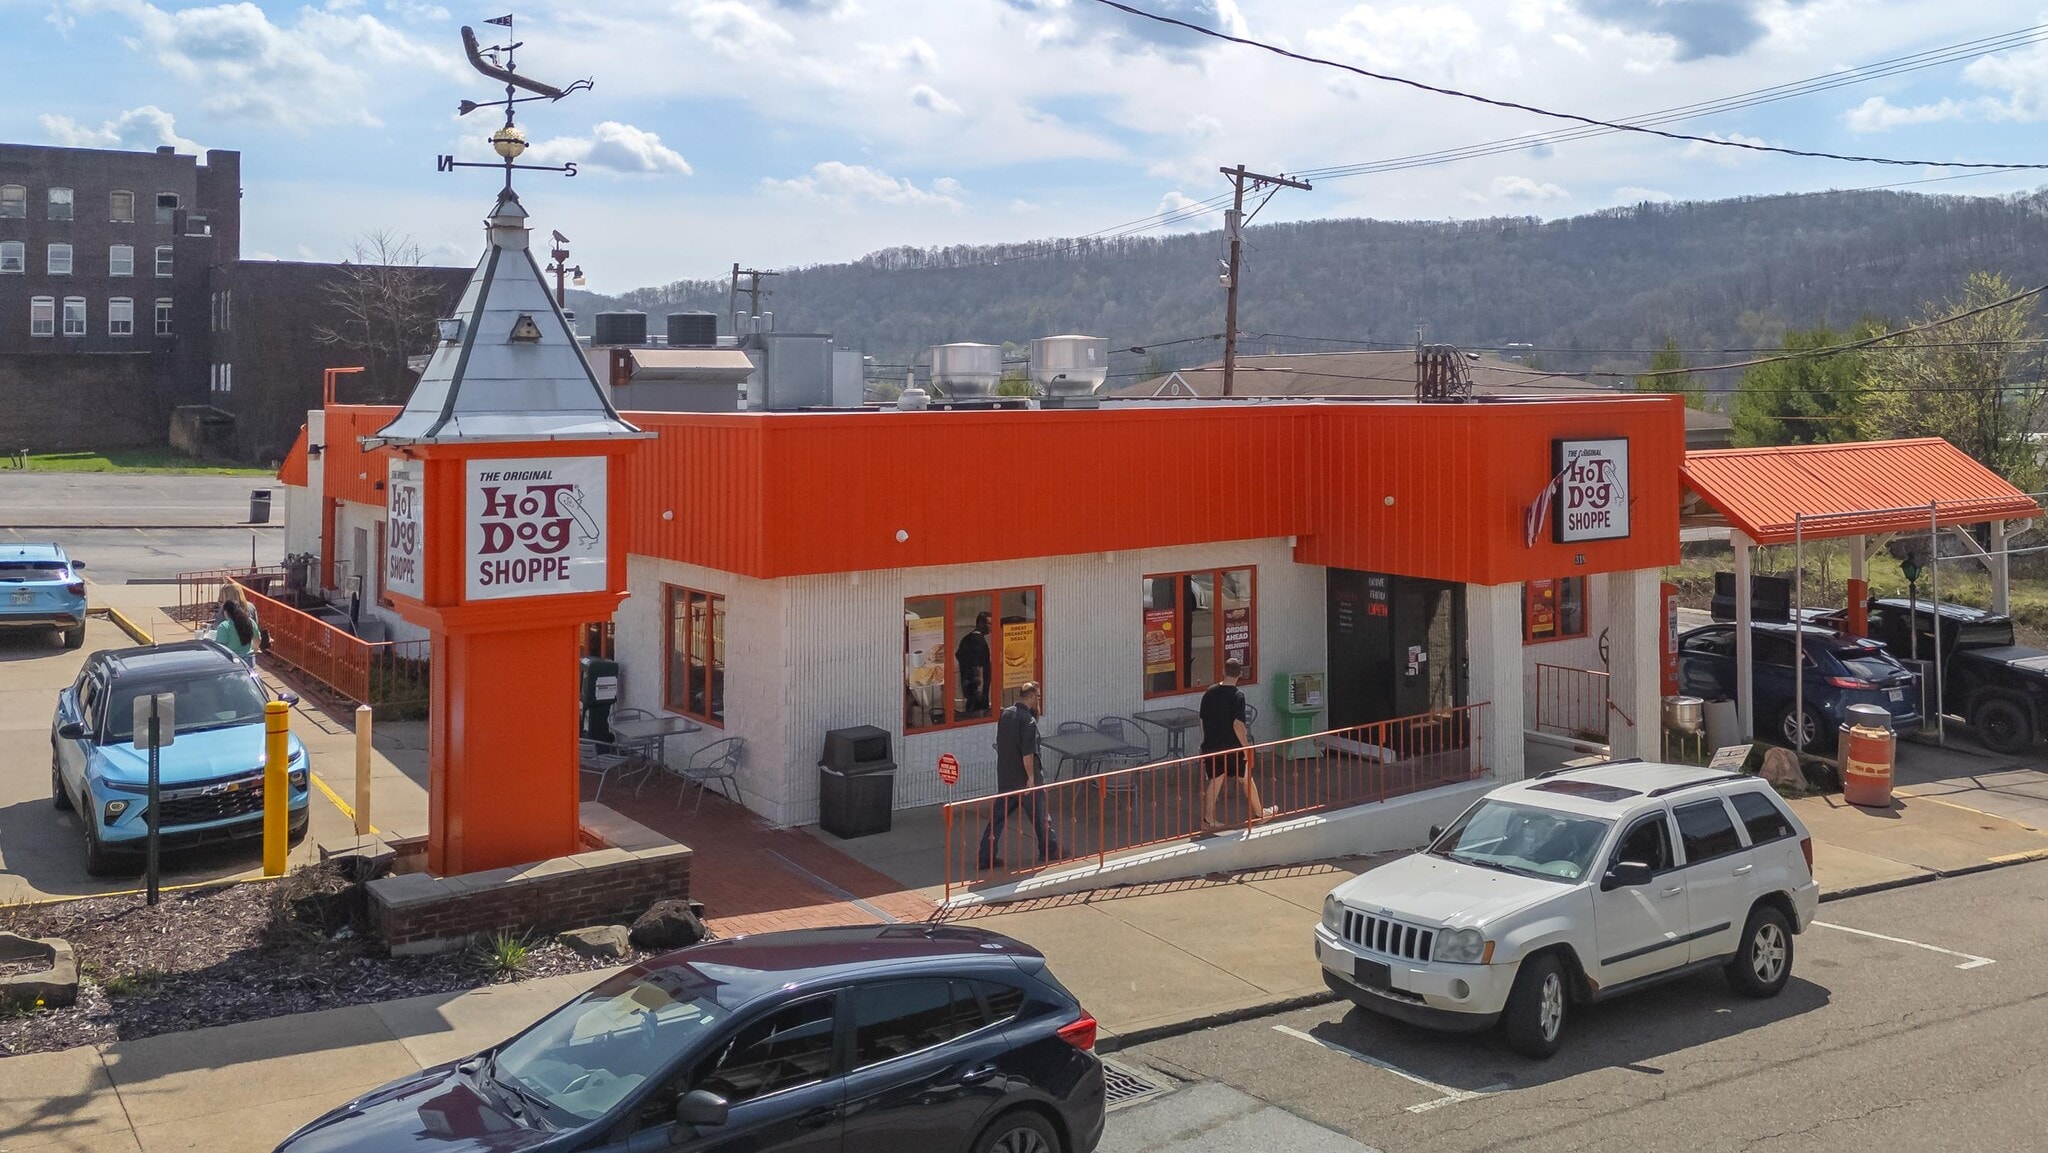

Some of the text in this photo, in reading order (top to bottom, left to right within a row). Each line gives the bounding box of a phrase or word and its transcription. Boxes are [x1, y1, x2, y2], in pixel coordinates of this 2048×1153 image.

[565, 162, 577, 177] S
[479, 470, 553, 482] THE ORIGINAL
[1568, 510, 1611, 531] SHOPPE
[390, 554, 415, 584] SHOPPE
[479, 556, 571, 586] SHOPPE
[1368, 577, 1385, 587] DRIVE
[1369, 589, 1386, 600] THRU
[1369, 603, 1388, 617] OPEN
[1225, 625, 1249, 634] ORDER
[1225, 632, 1249, 642] AHEAD
